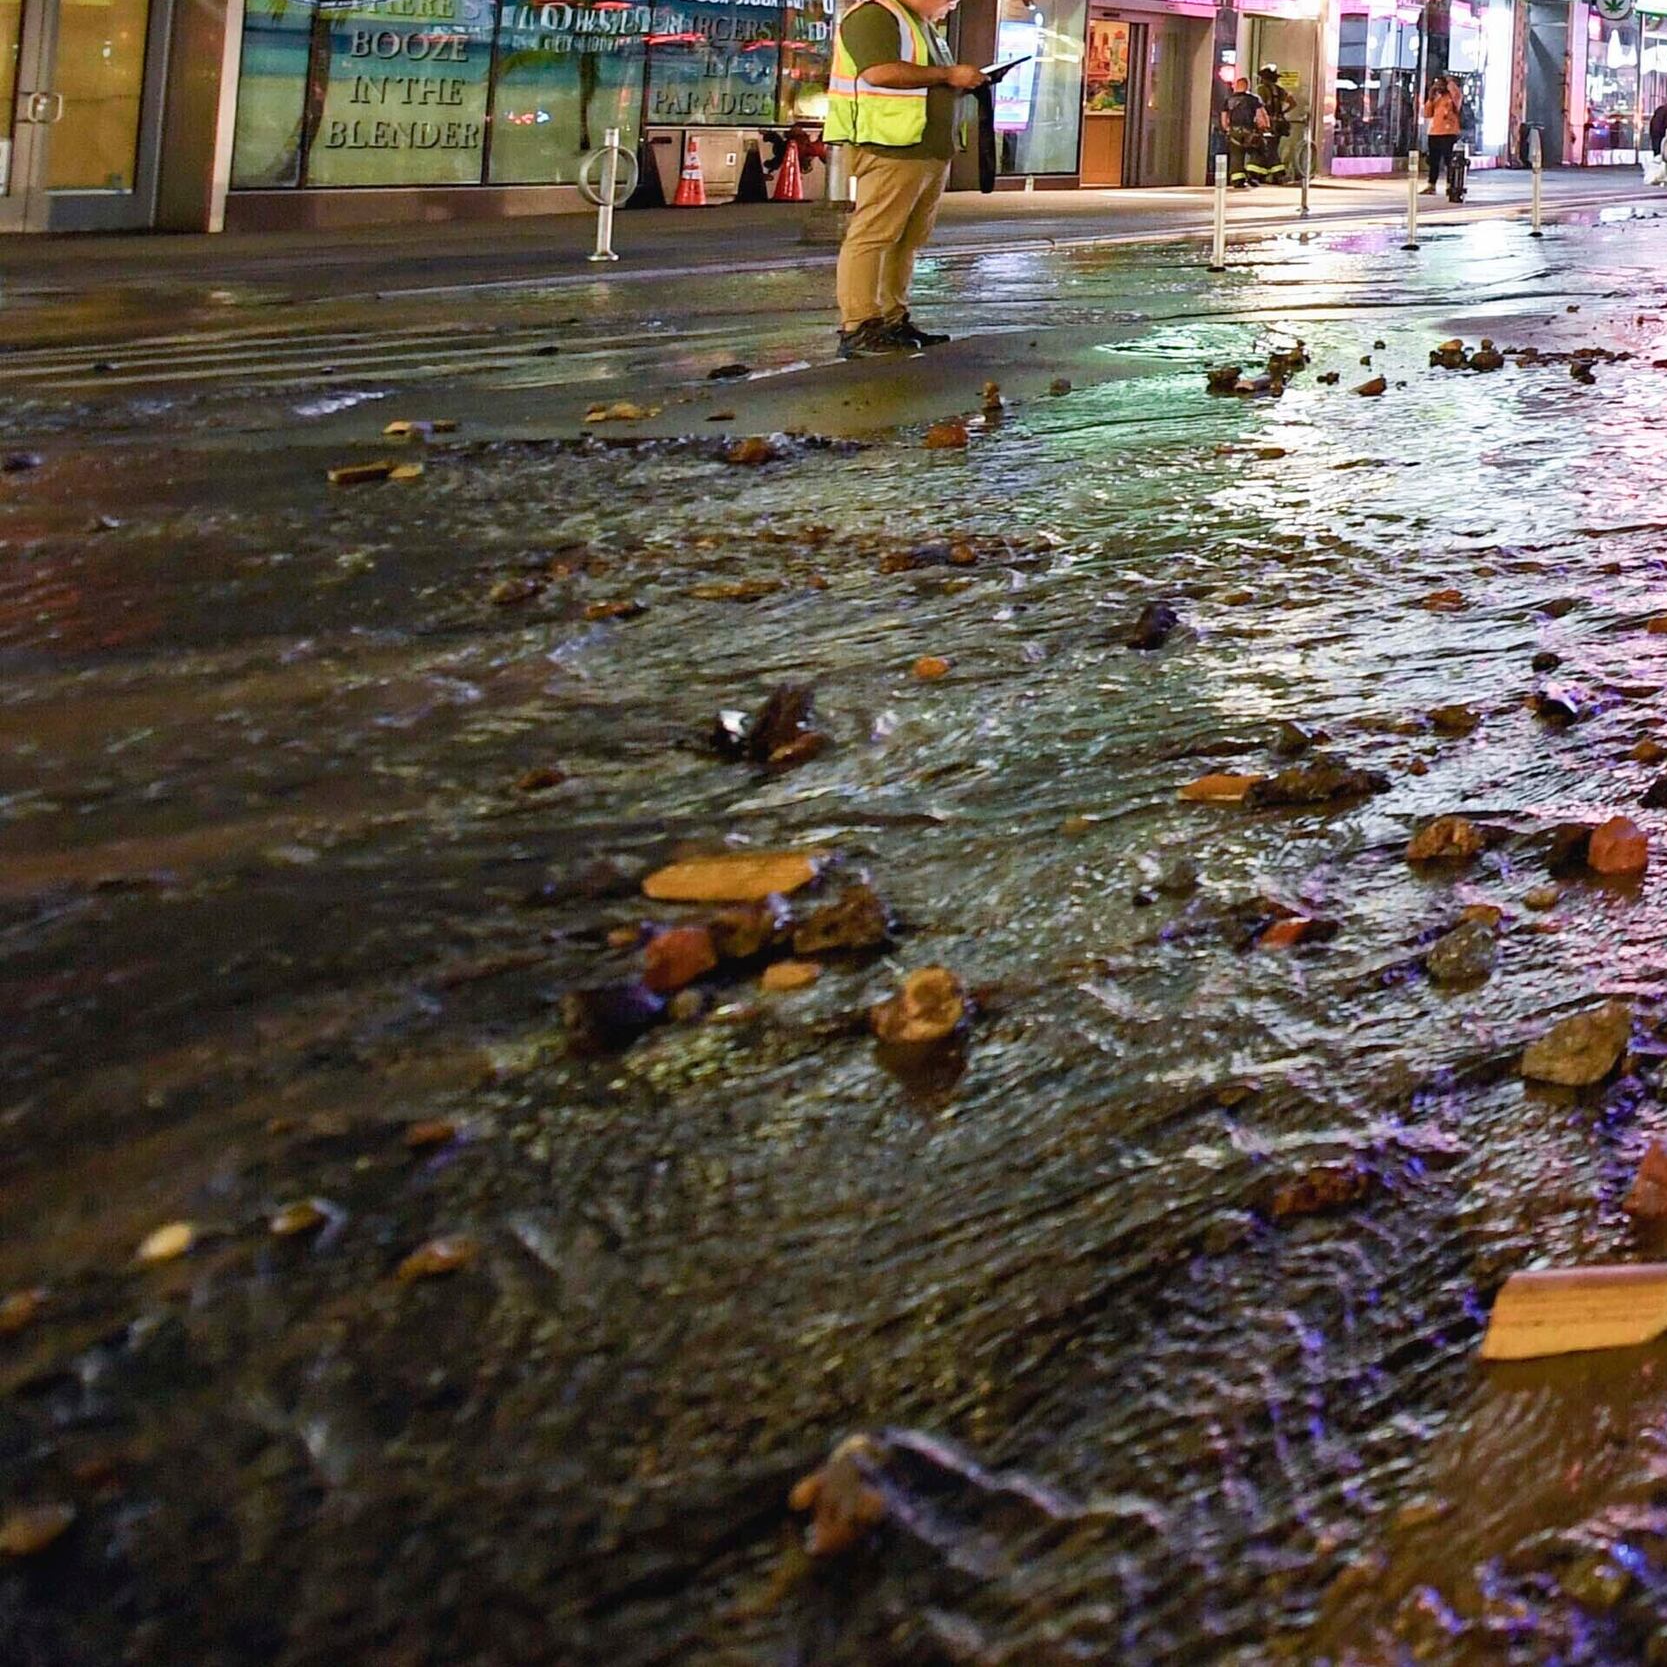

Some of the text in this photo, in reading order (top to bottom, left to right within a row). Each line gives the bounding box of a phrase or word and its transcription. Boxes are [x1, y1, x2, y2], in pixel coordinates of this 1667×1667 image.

[350, 29, 469, 62] BOOZE
[350, 75, 466, 106] IN THE
[654, 89, 773, 116] PARADISE
[325, 121, 479, 150] BLENDER
